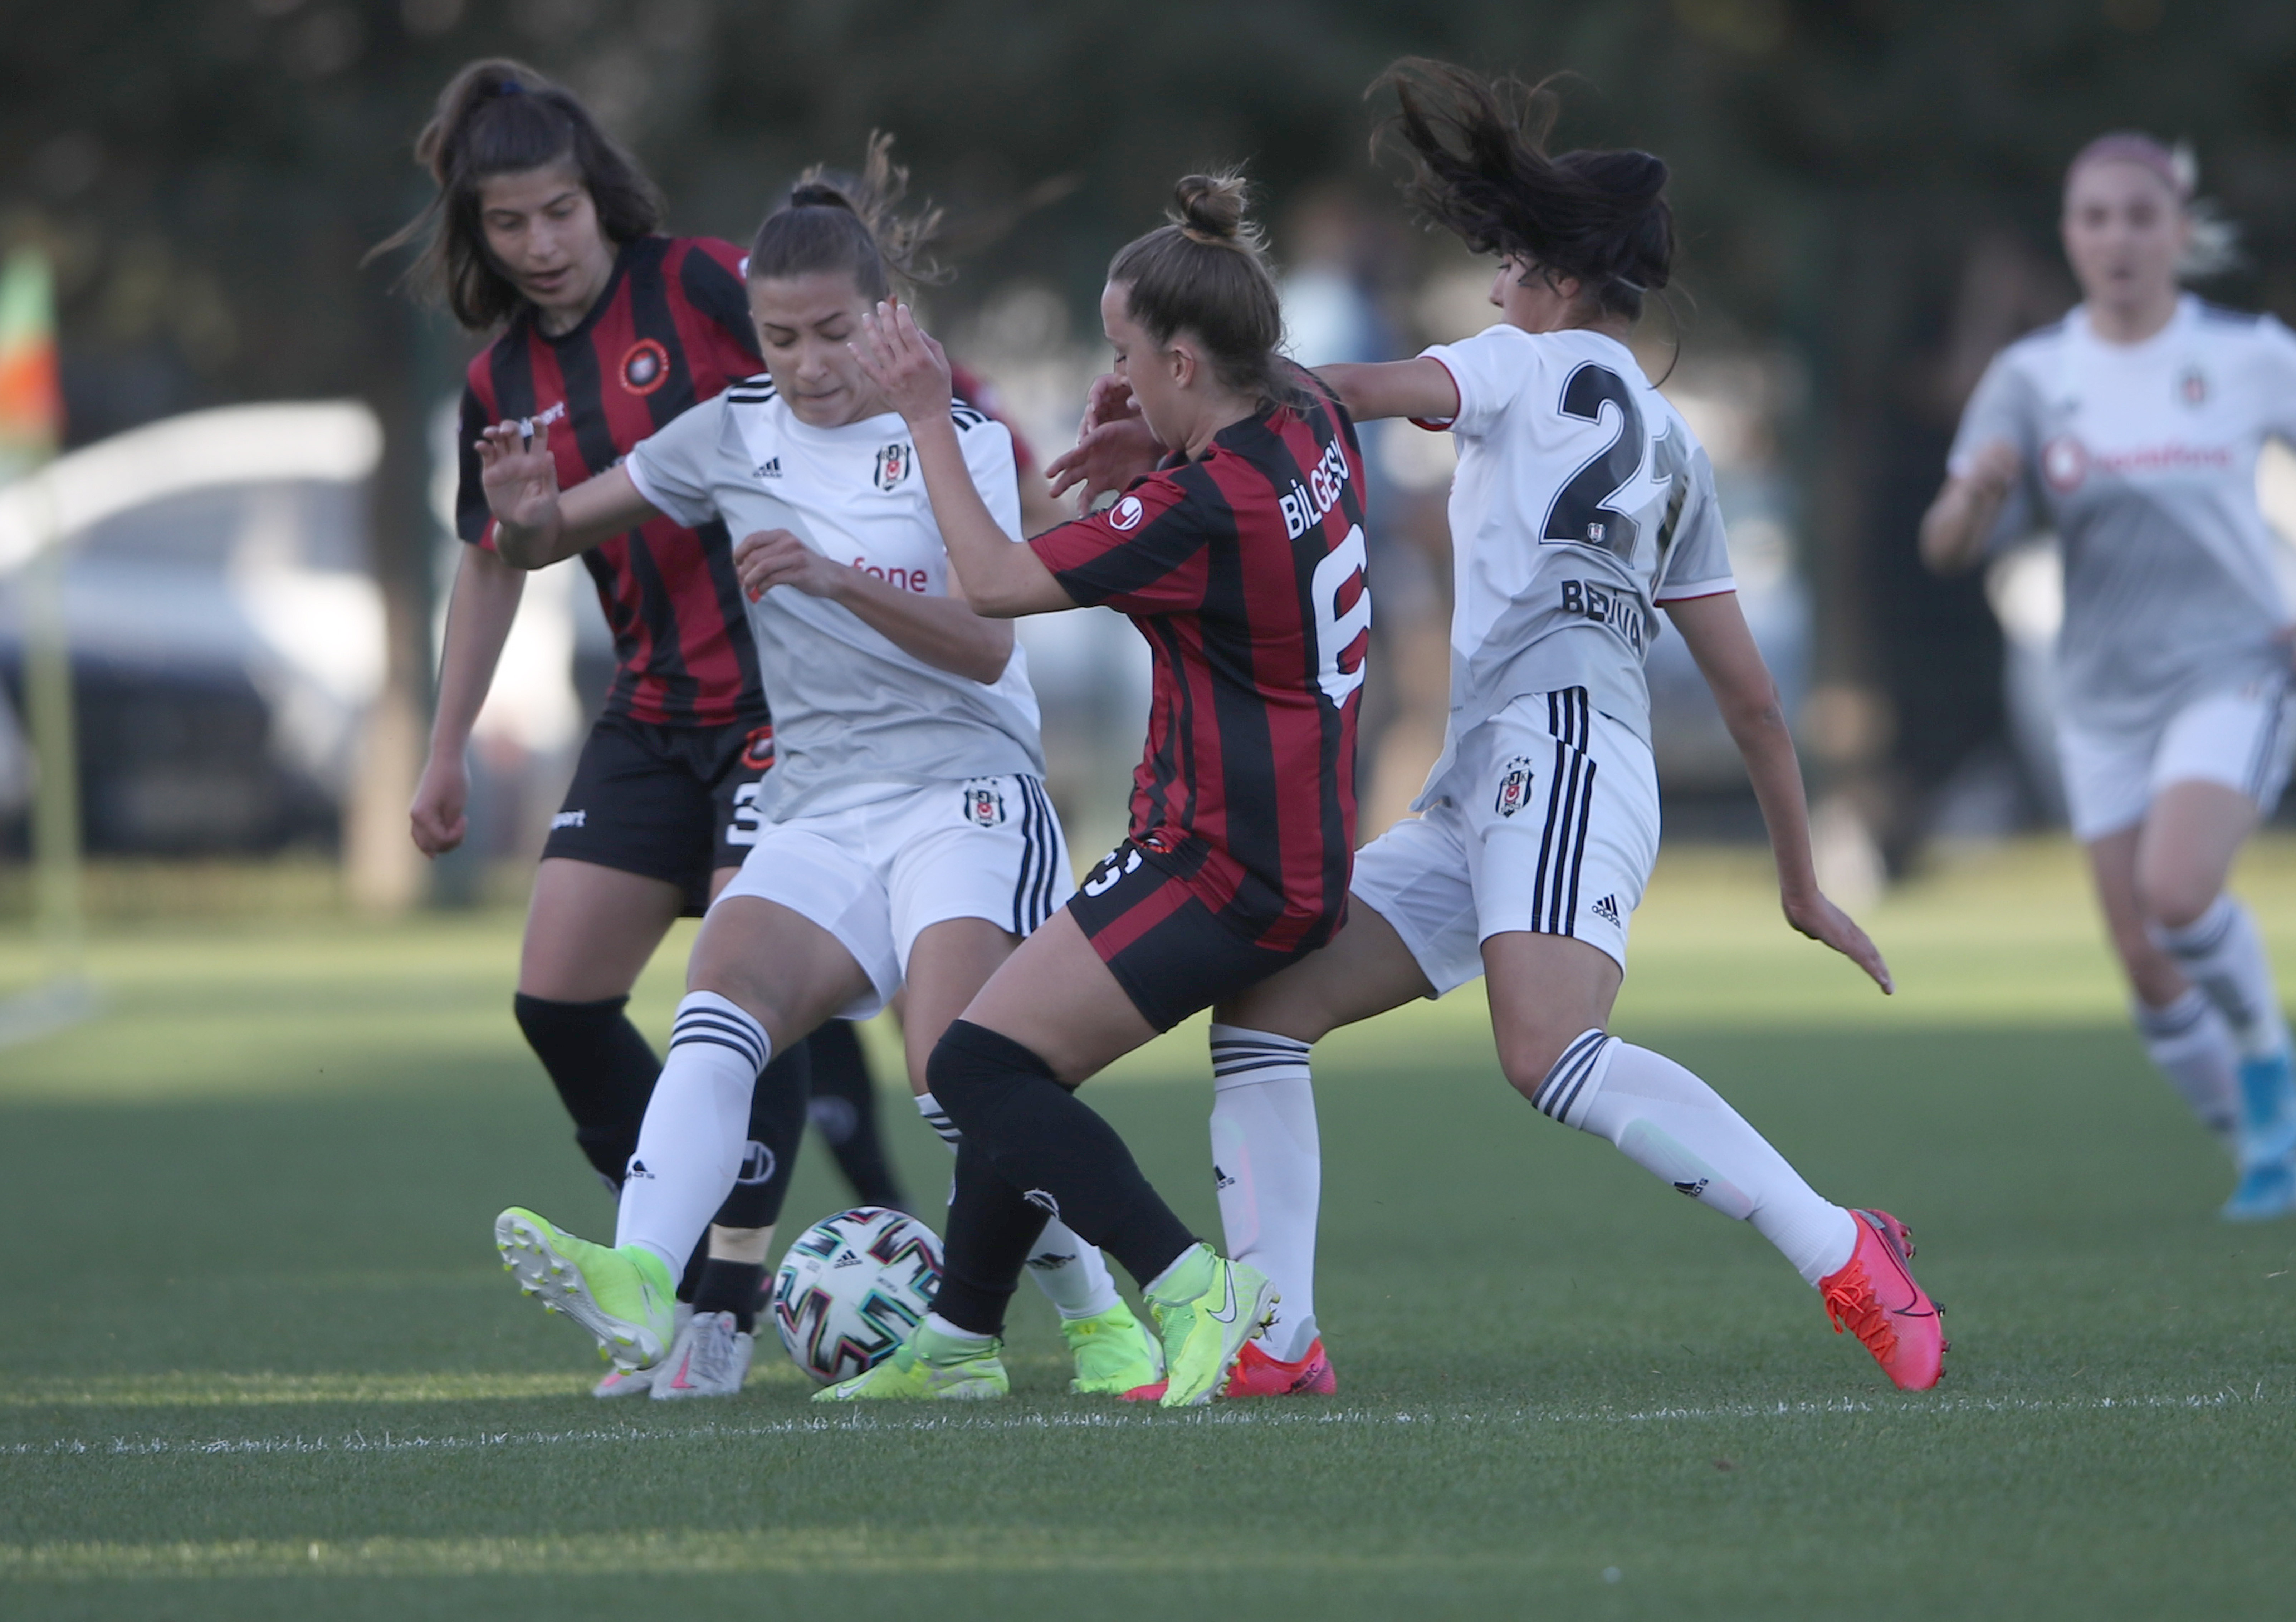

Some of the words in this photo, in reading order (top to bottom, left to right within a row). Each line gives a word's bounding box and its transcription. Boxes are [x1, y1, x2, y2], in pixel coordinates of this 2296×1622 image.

[1278, 433, 1350, 541] BİLGESU
[1311, 522, 1373, 710] 6
[1592, 905, 1621, 929] adidas
